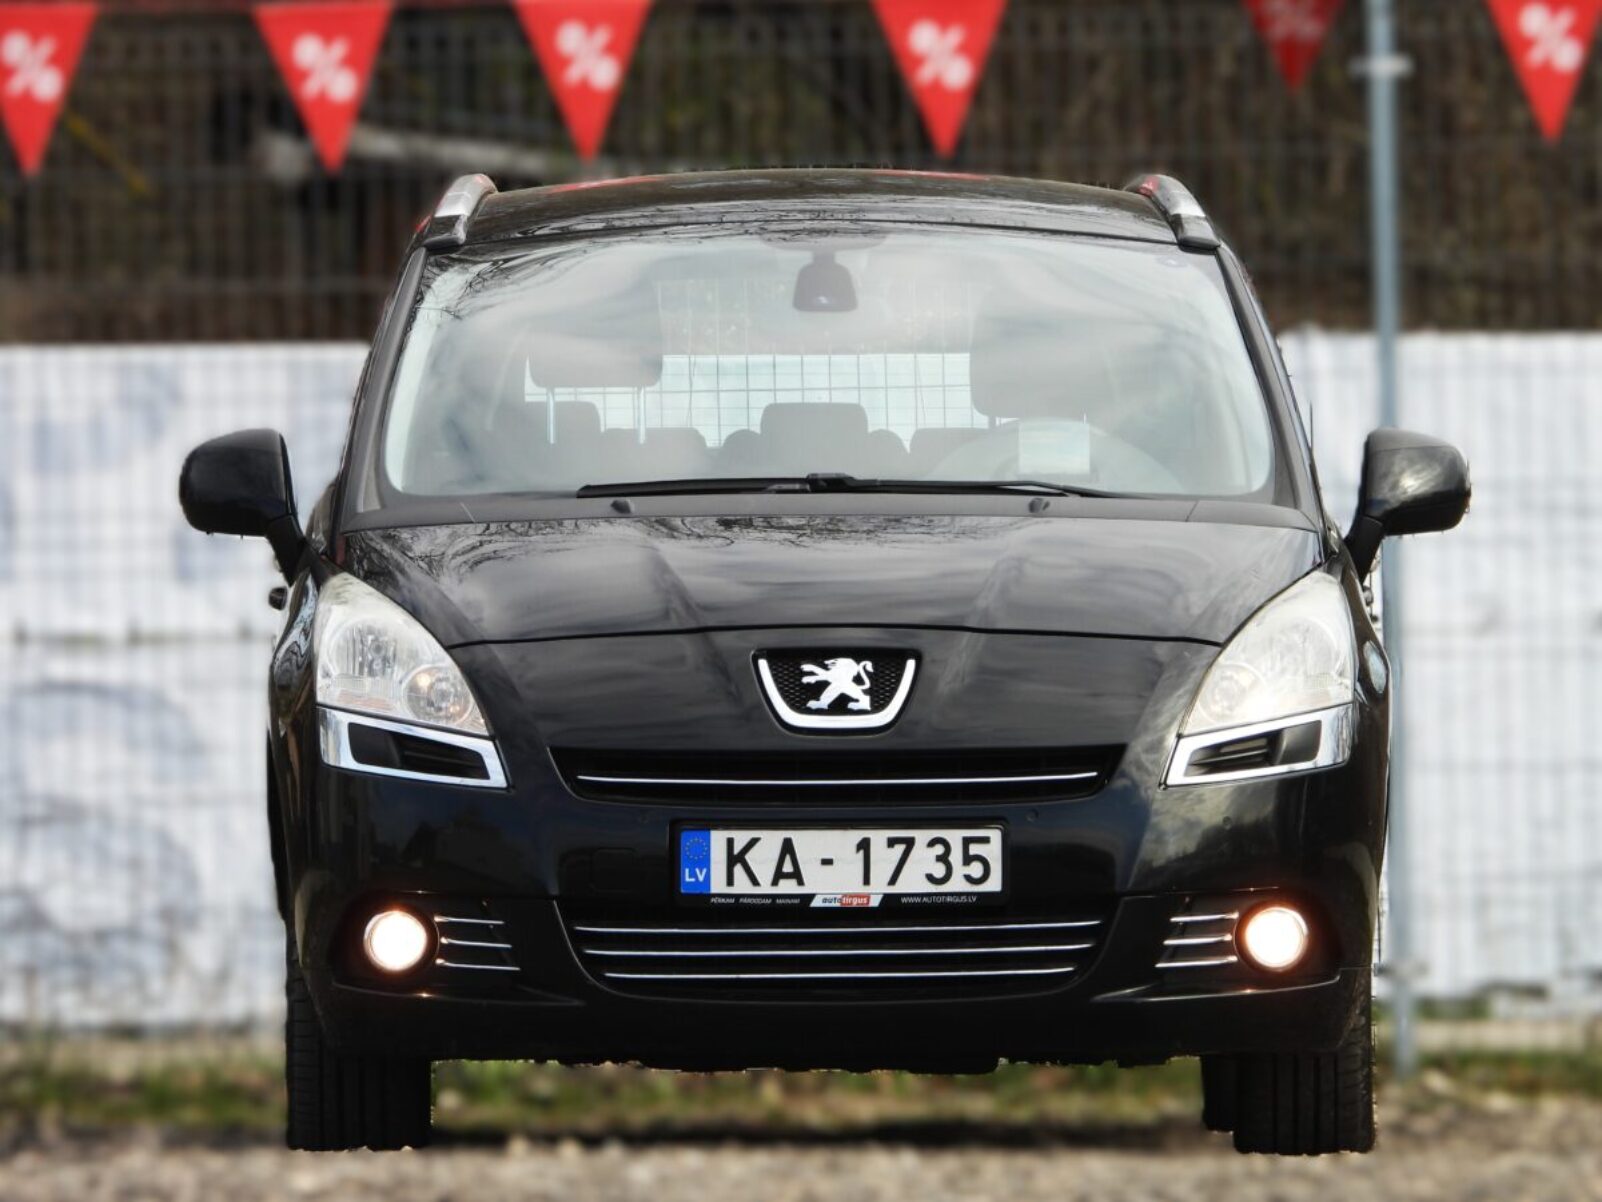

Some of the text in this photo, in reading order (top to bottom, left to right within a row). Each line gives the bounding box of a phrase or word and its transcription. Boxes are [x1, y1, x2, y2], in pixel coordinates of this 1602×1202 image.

[0, 32, 62, 102] %
[292, 34, 358, 103] %
[556, 21, 620, 91] %
[908, 20, 974, 91] %
[1520, 2, 1584, 73] %
[685, 867, 707, 882] LV
